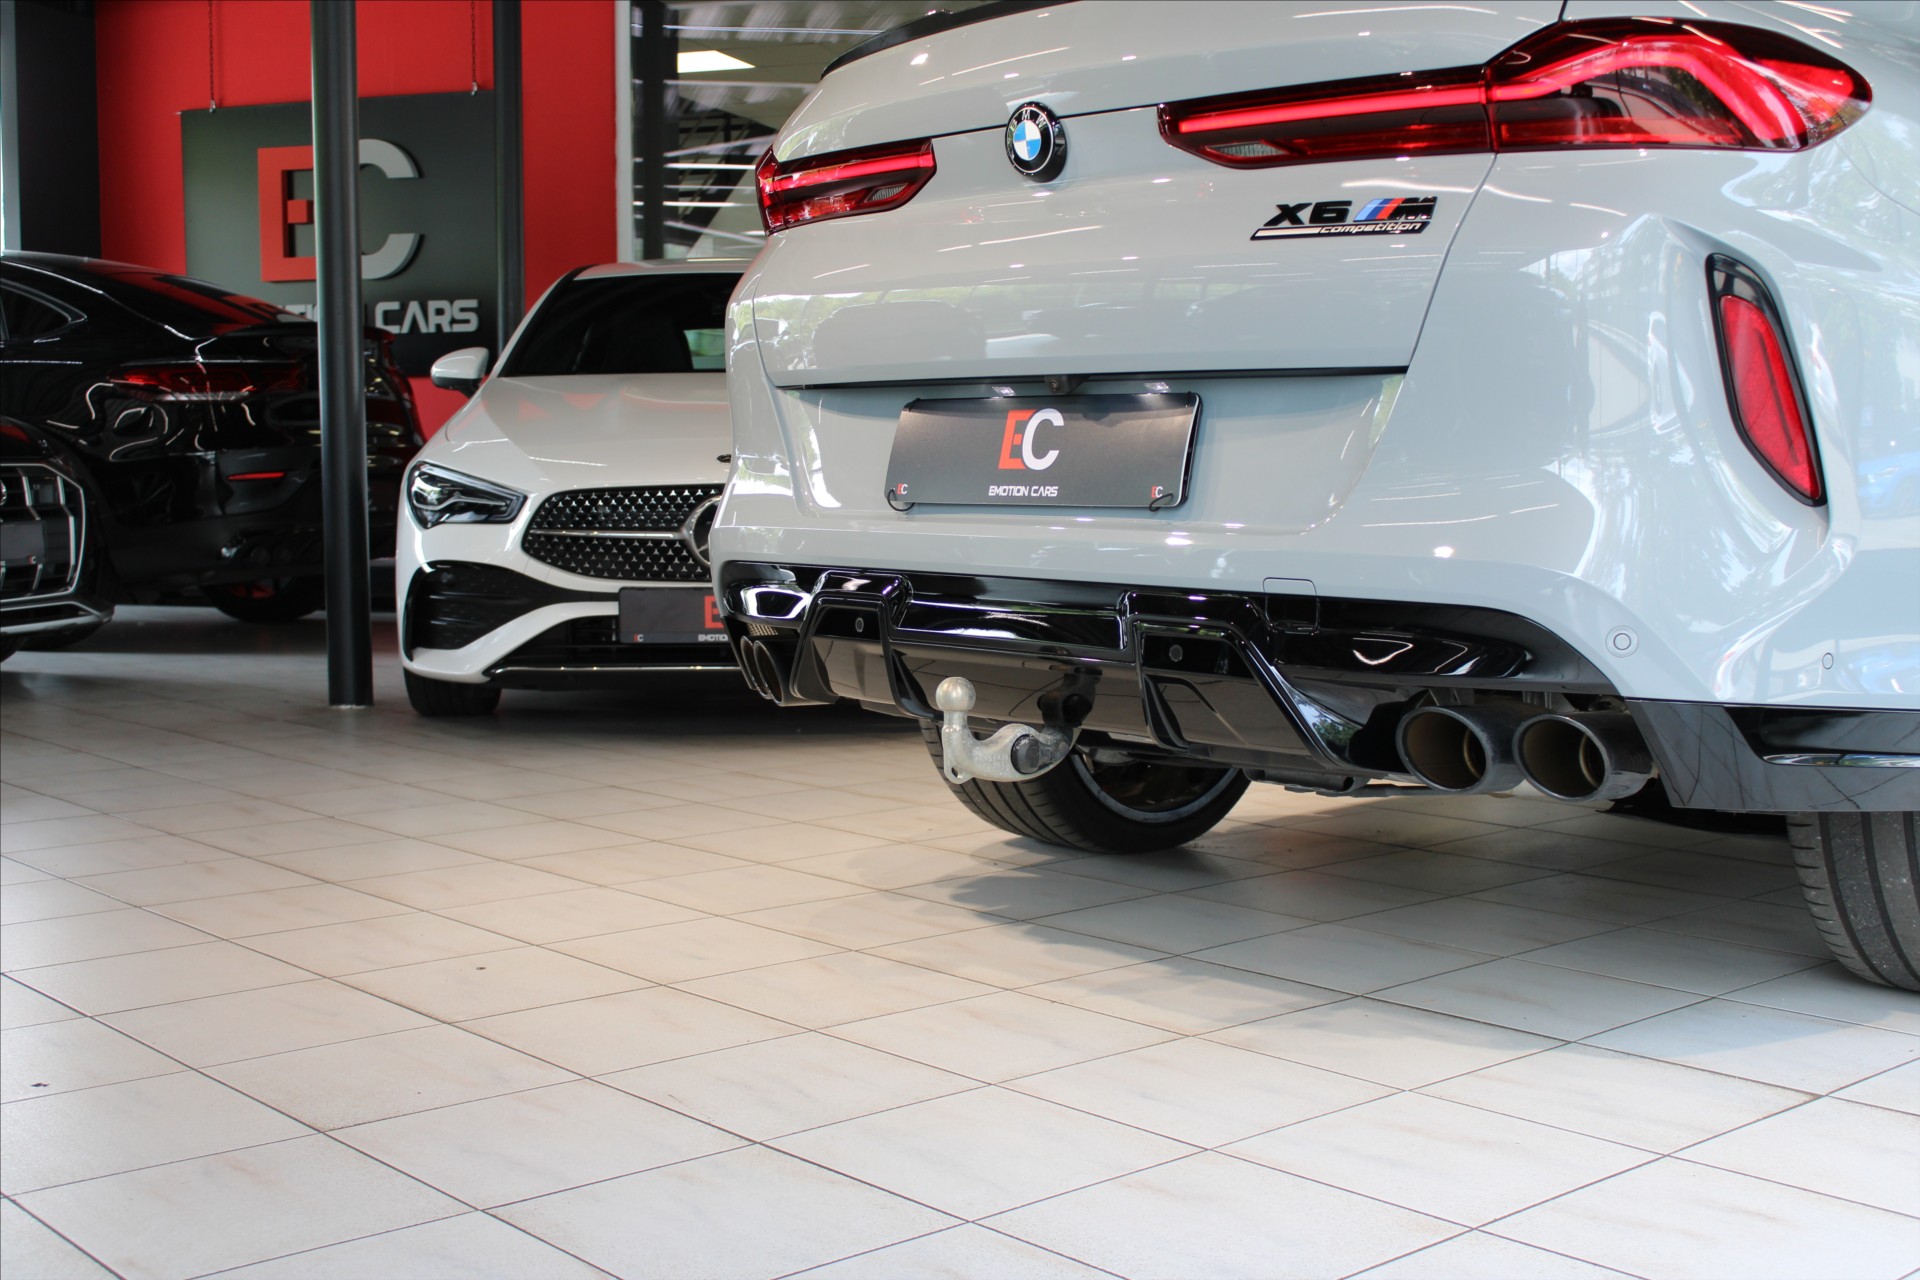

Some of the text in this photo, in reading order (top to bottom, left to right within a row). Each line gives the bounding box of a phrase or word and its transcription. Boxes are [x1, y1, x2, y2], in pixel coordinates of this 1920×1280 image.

[1009, 109, 1047, 132] BMW
[1263, 200, 1353, 227] X6
[1319, 221, 1420, 234] competition
[375, 299, 479, 334] CARS
[998, 407, 1065, 471] EC
[988, 485, 1059, 497] EMOTION CARS
